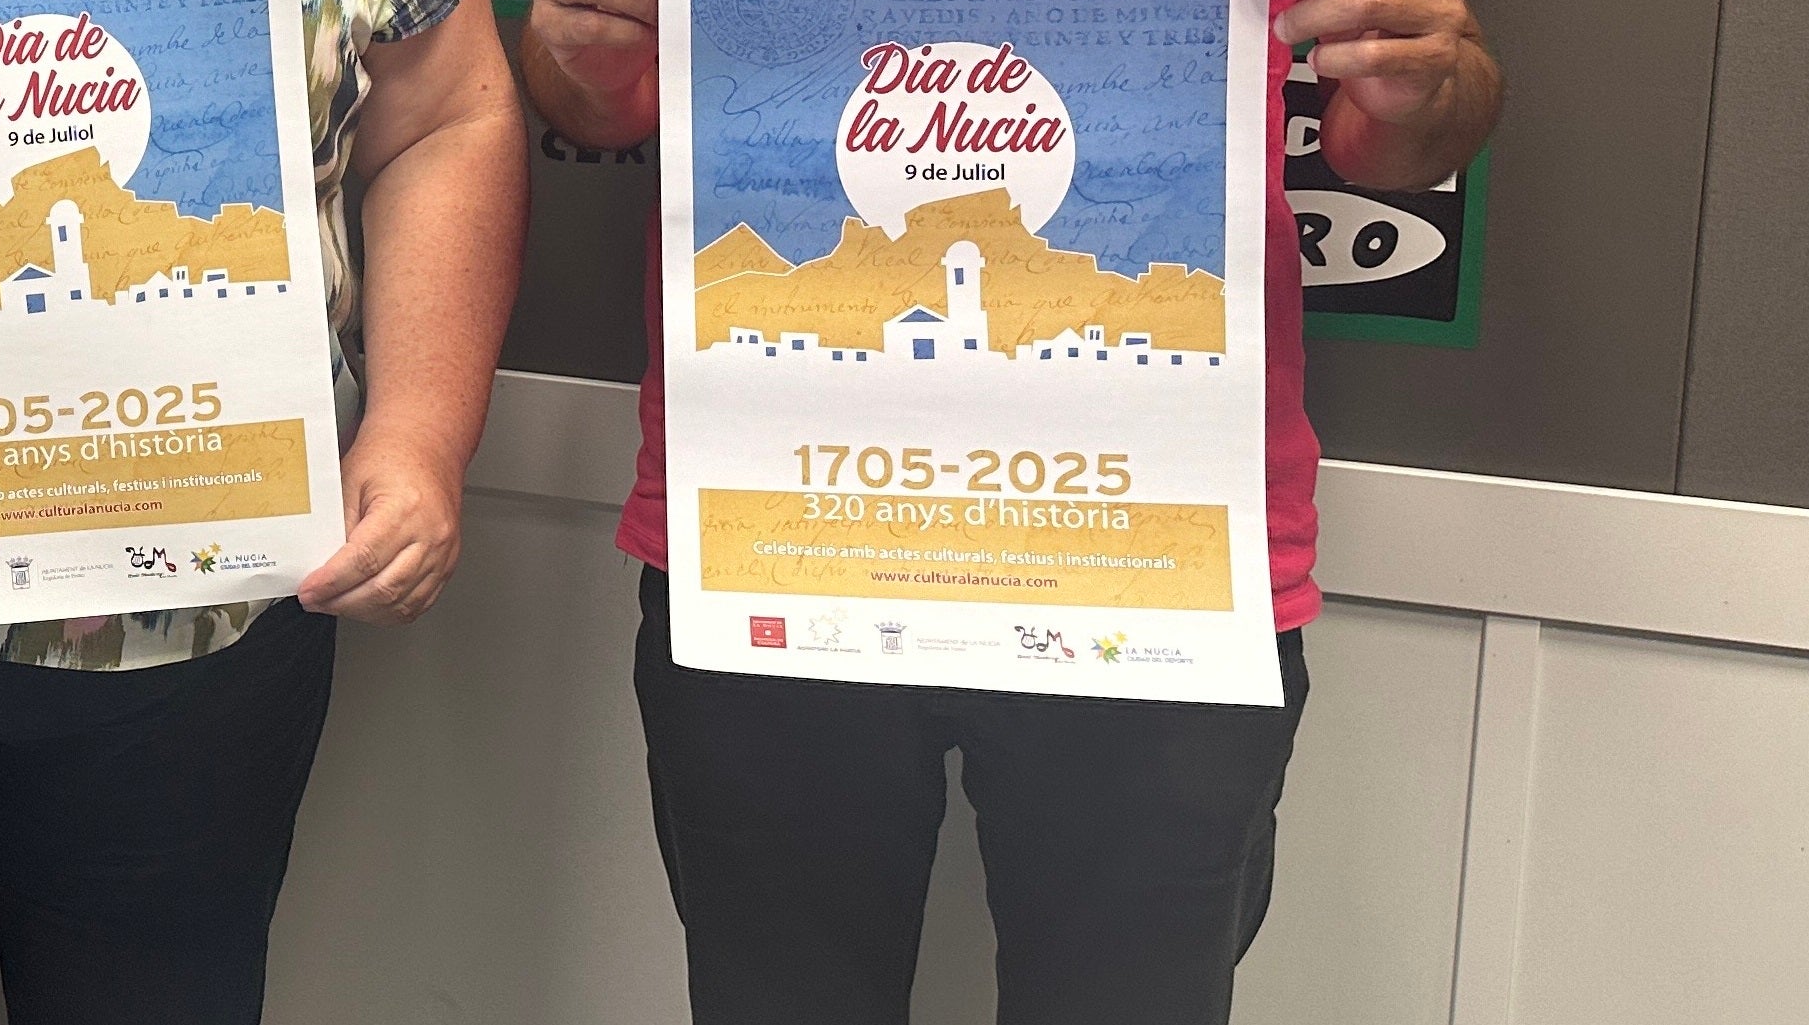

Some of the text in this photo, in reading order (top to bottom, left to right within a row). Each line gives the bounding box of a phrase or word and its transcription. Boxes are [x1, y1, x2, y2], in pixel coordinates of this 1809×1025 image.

[55, 14, 108, 61] de
[862, 43, 1032, 94] Dia de
[8, 67, 141, 121] Nucia
[8, 124, 94, 146] 9 de Juliol
[846, 99, 1066, 153] la Nucia
[905, 164, 1005, 180] 9 de Juliol
[1294, 213, 1399, 268] RO
[3, 440, 71, 470] anys
[793, 444, 1131, 496] 1705-2025
[8, 485, 43, 500] actes
[46, 480, 111, 499] culturals,
[113, 477, 159, 492] festius
[169, 469, 263, 489] institucionals
[1, 499, 163, 521] www.culturalanucia.com
[802, 494, 864, 521] 320
[875, 502, 953, 531] anys
[753, 540, 837, 557] Celebració
[839, 546, 875, 560] amb
[879, 548, 920, 562] actes
[924, 548, 998, 565] culturals,
[1000, 550, 1054, 566] festius
[1065, 552, 1177, 570] institucionals
[871, 569, 1058, 589] www.culturalanucia.com
